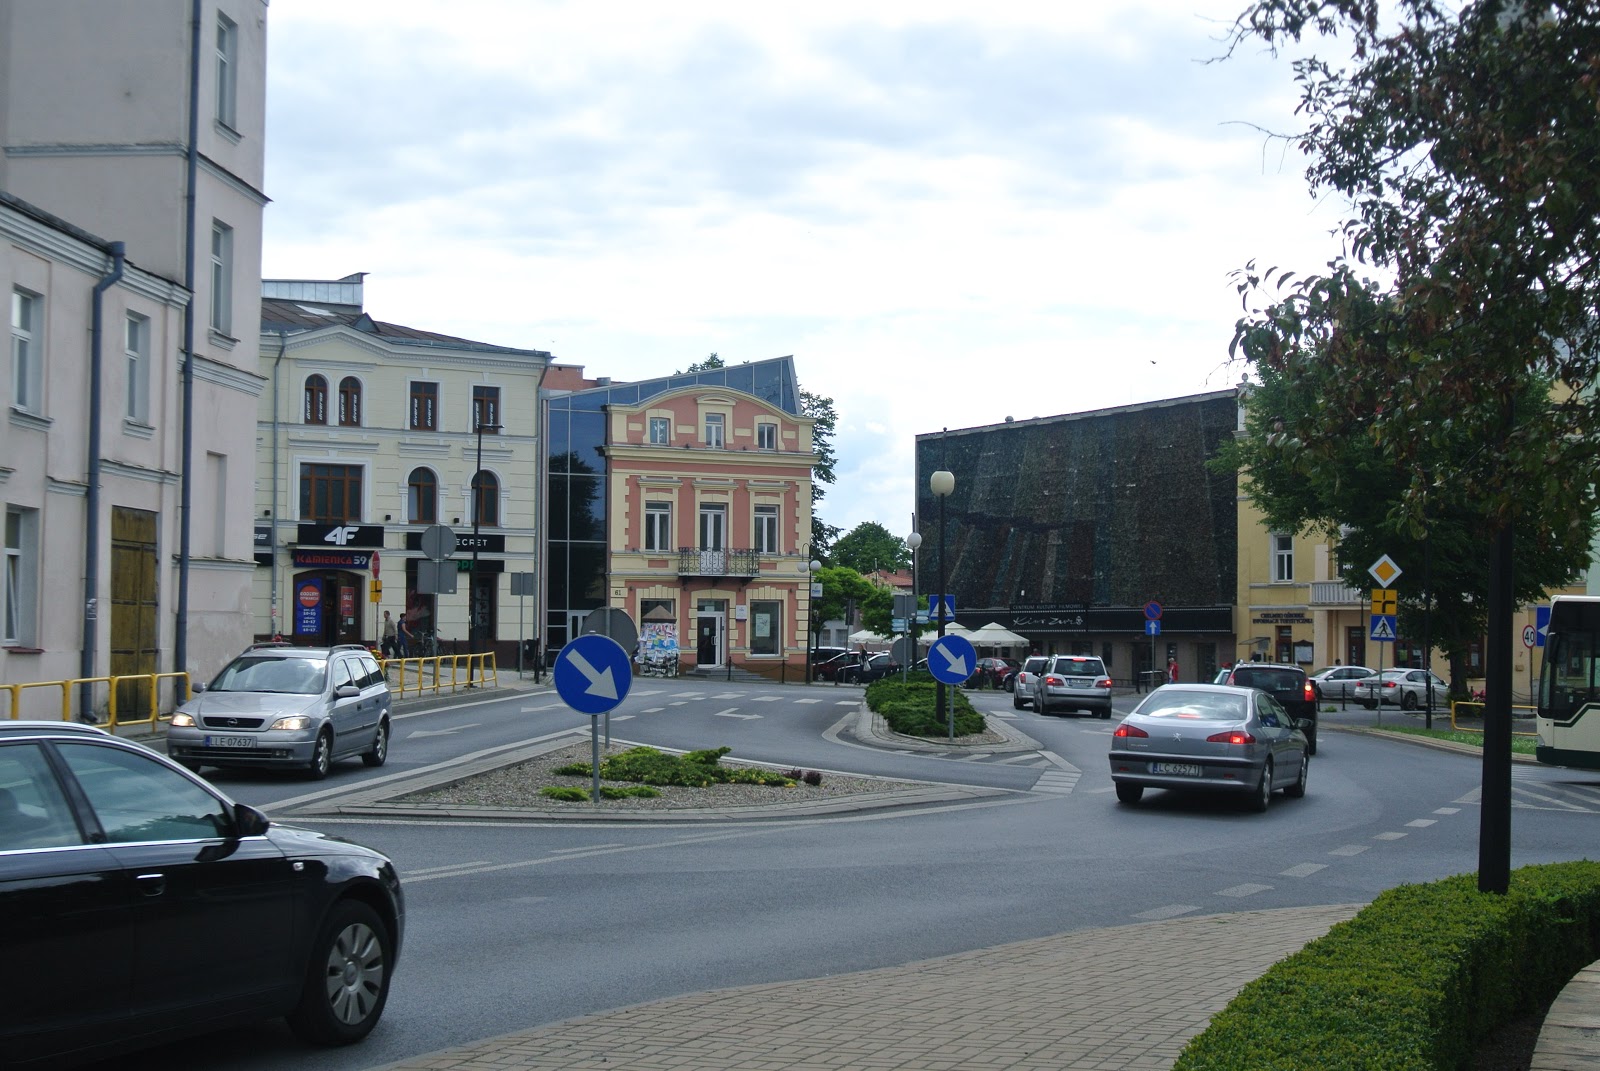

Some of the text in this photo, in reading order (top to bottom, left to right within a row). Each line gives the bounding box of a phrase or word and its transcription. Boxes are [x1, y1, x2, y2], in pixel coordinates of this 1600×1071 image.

[324, 526, 360, 545] 4F
[456, 538, 488, 546] ECRET
[296, 556, 367, 564] KAMIENICA 59
[1524, 631, 1534, 642] 40
[210, 738, 252, 746] LLE 07637
[1159, 764, 1197, 774] LC 62571
